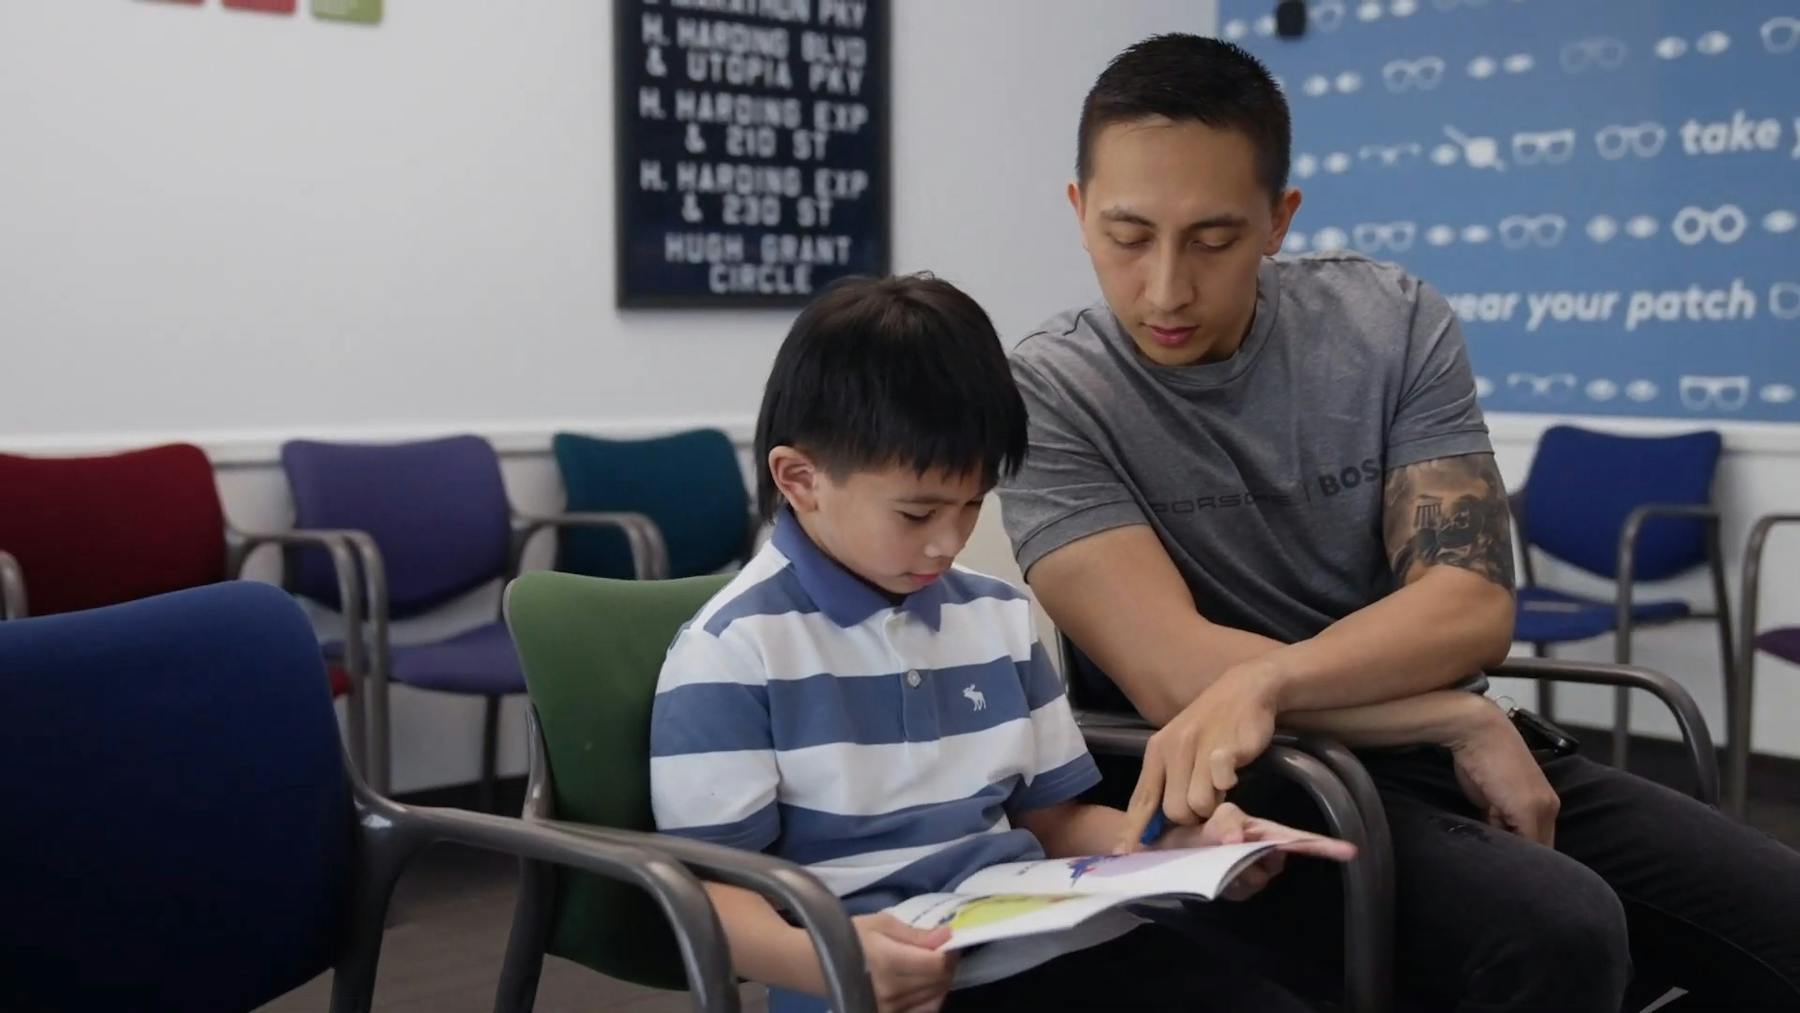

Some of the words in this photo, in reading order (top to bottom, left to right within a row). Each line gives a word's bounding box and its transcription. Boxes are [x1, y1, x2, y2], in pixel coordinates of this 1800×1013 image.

[676, 17, 789, 59] HARDING
[686, 50, 793, 89] UTOPIA
[808, 62, 864, 95] PKY
[675, 90, 801, 129] HARDING
[813, 100, 869, 134] EXP
[725, 124, 776, 158] 210
[792, 128, 829, 160] ST
[1681, 109, 1780, 155] take
[676, 162, 802, 197] HARDING
[814, 168, 869, 200] EXP
[722, 194, 781, 226] 230
[796, 196, 832, 227] ST
[664, 232, 744, 264] HUGH
[760, 234, 852, 265] GRANT
[709, 263, 812, 294] CIRCLE
[1526, 291, 1619, 331] your
[1625, 280, 1756, 331] patch
[1318, 458, 1381, 497] BOS
